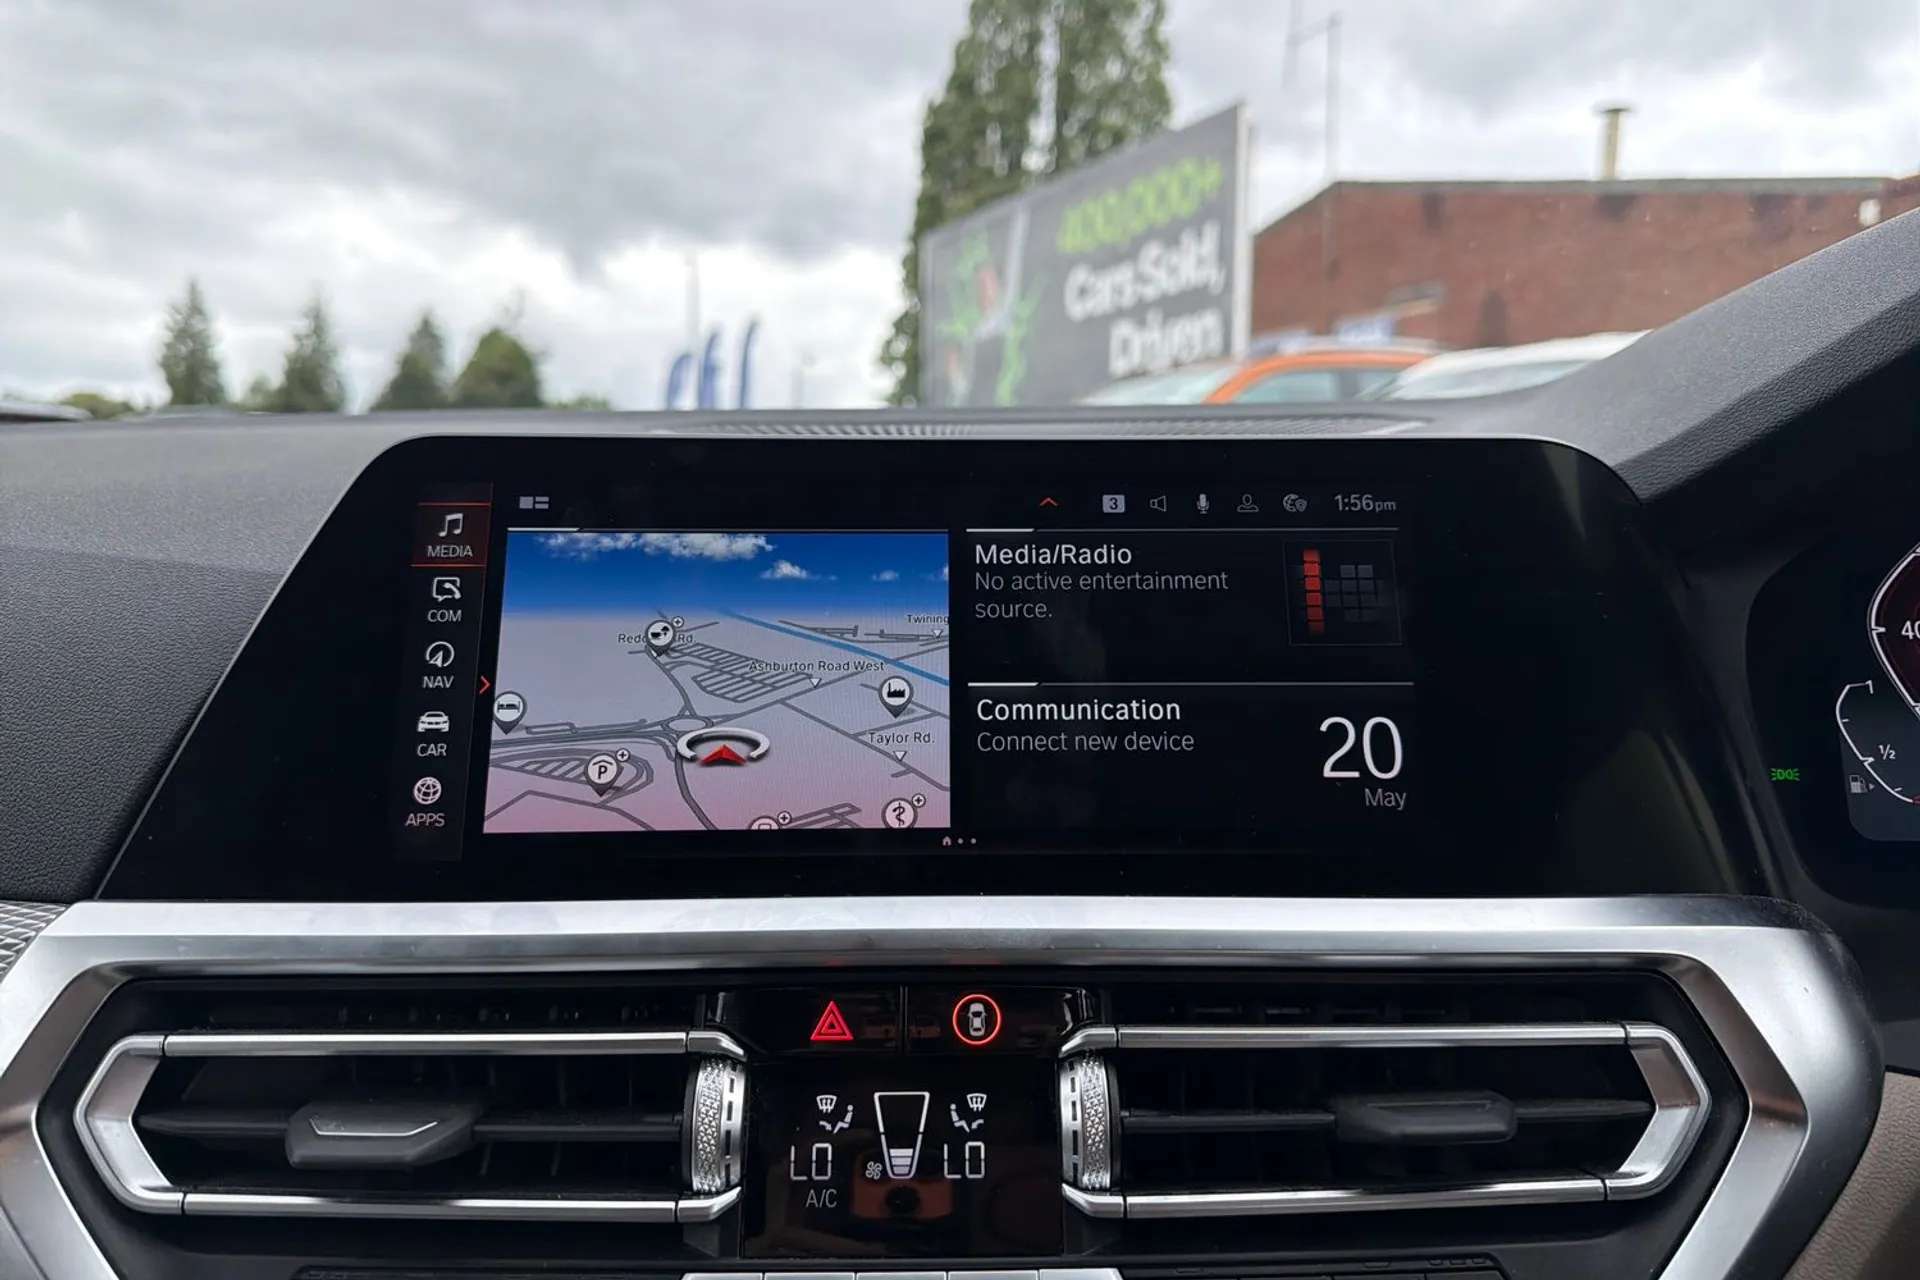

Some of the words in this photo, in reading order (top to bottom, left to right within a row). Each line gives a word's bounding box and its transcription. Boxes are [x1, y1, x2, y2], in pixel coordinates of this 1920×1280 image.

[1064, 261, 1136, 321] Cars
[1109, 307, 1223, 375] Driven
[426, 544, 473, 558] MEDIA
[975, 542, 1133, 566] Media/Radio
[975, 571, 1004, 592] No
[1011, 571, 1073, 592] active
[1078, 570, 1229, 592] entertainment
[427, 608, 462, 623] COM
[974, 601, 1053, 620] source.
[749, 660, 813, 672] Ashburton
[818, 660, 849, 671] Road
[853, 660, 884, 671] West
[422, 675, 455, 690] NAV
[976, 699, 1181, 721] Communication
[868, 732, 908, 745] Taylor
[913, 732, 935, 743] Rd.
[977, 731, 1068, 752] Connect
[1074, 735, 1121, 752] new
[1125, 731, 1195, 752] device
[1320, 716, 1403, 780] 20
[417, 742, 447, 757] CAR
[1364, 788, 1407, 810] May
[406, 813, 445, 828] APPS
[806, 1189, 837, 1208] A/C
